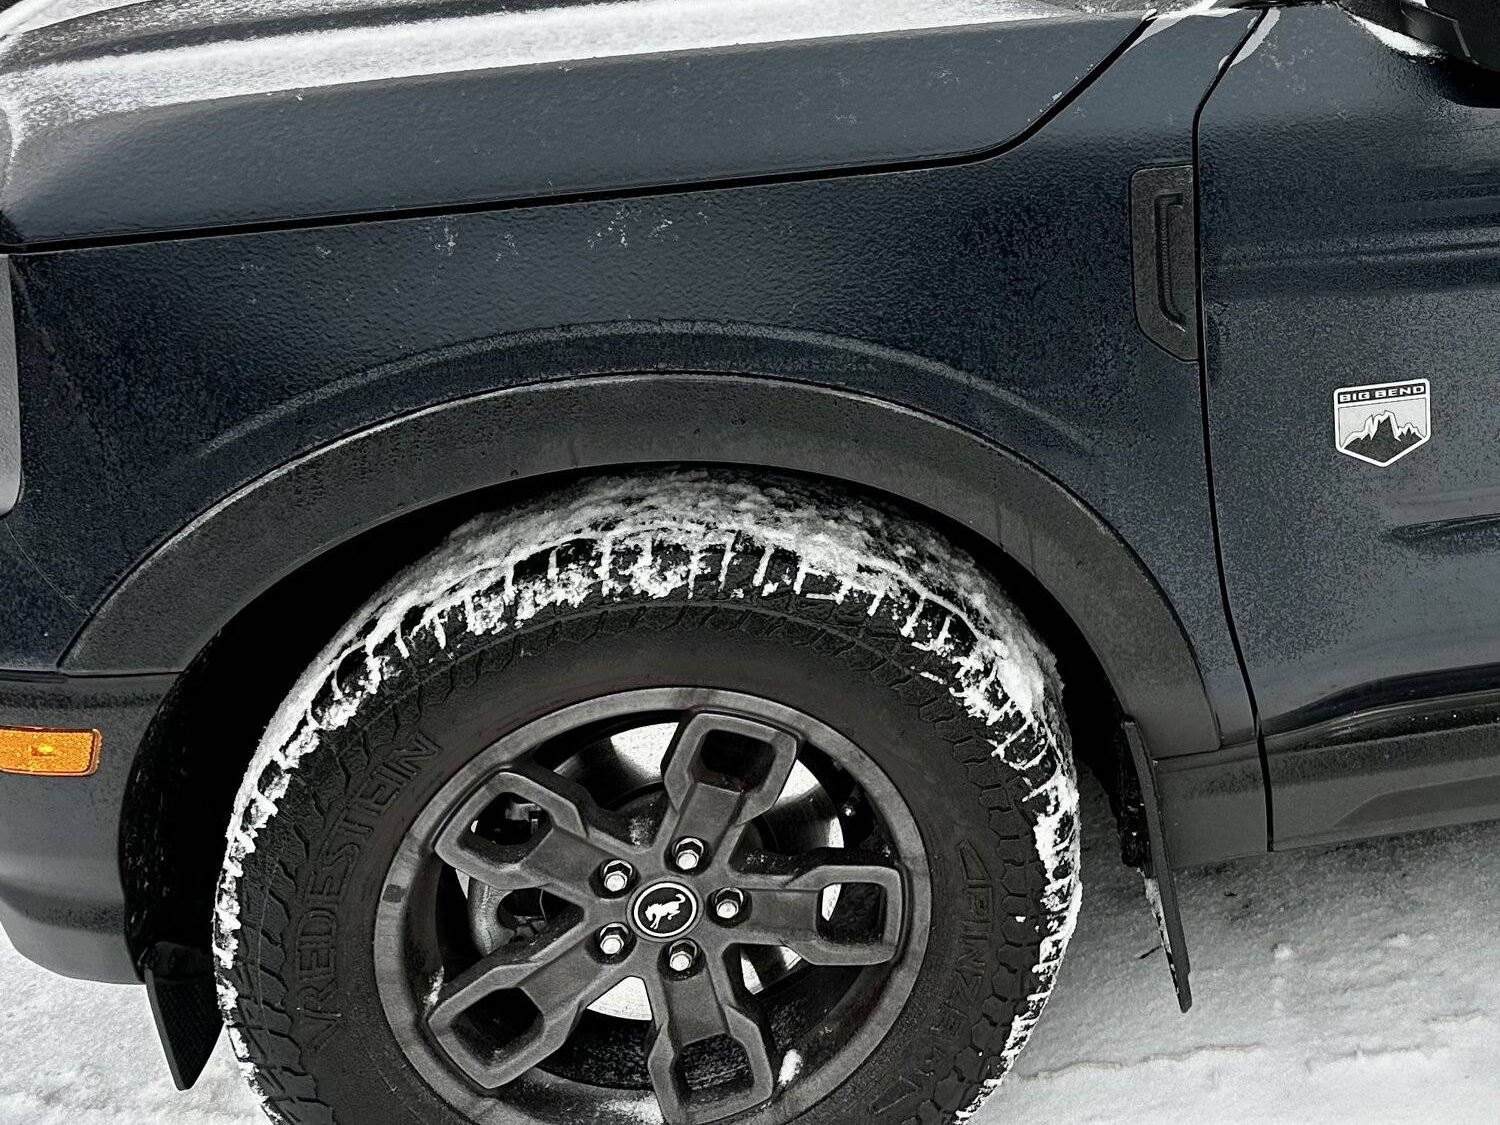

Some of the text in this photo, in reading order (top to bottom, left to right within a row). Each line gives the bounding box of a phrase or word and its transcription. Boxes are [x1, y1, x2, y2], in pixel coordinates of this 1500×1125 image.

[1339, 385, 1425, 402] BIG BEND
[297, 729, 443, 1053] VREDESTEIN
